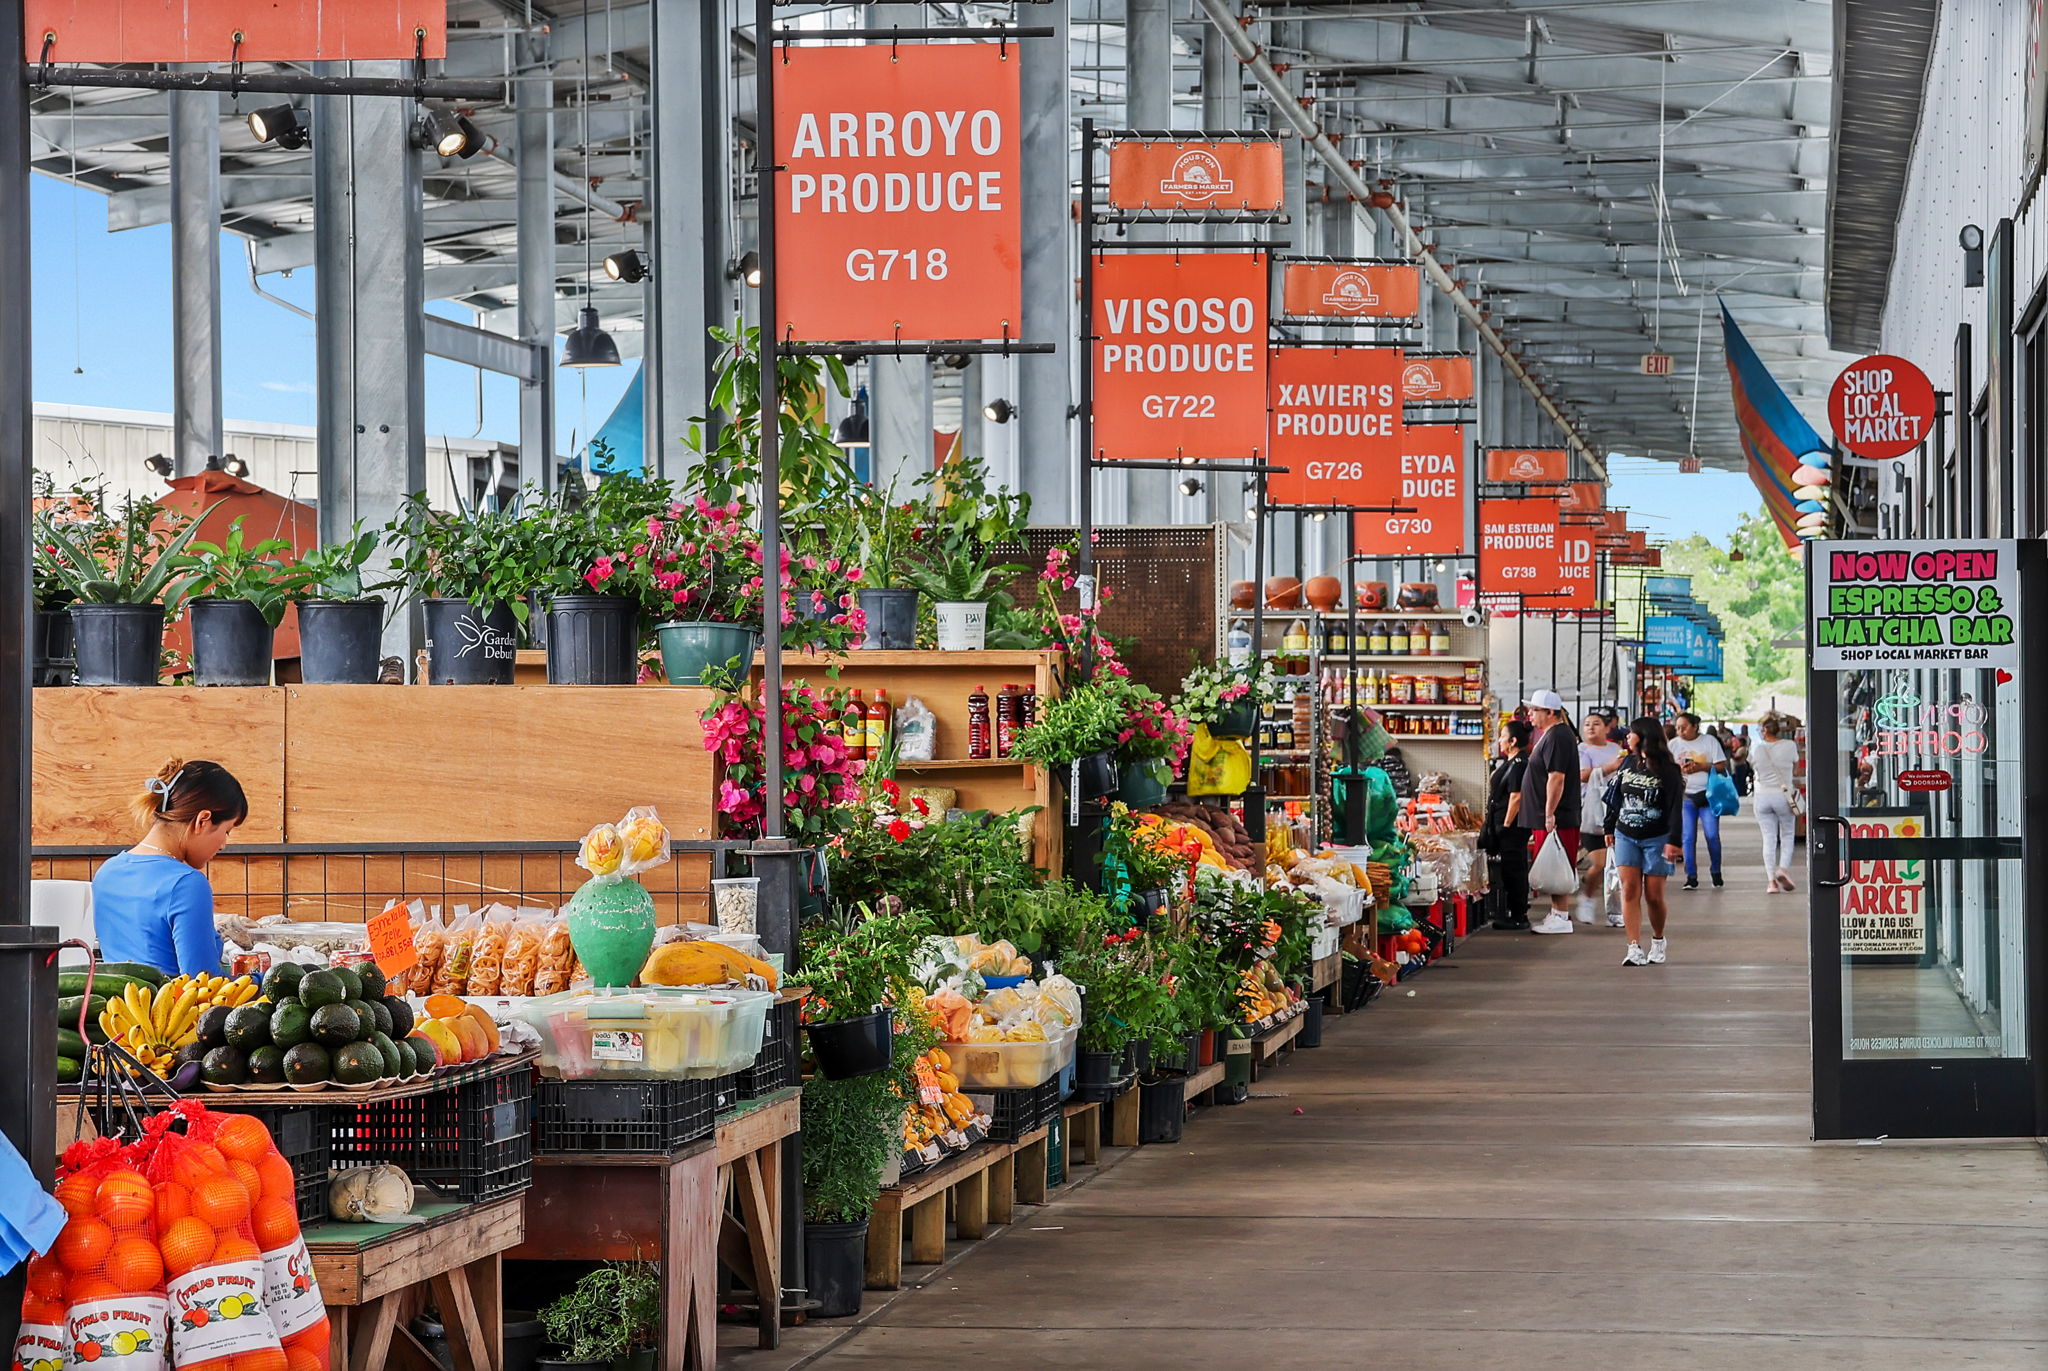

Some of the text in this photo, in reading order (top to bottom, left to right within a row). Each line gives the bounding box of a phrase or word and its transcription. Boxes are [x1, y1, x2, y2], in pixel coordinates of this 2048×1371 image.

[792, 109, 1002, 158] ARROYO
[1179, 155, 1215, 168] HOUSTON
[790, 171, 1002, 213] PRODUCE
[845, 249, 949, 282] G718
[1103, 297, 1255, 334] VISOSO
[1103, 343, 1254, 373] PRODUCE
[1647, 356, 1670, 373] EXIT
[1843, 368, 1893, 395] SHOP
[1141, 395, 1216, 420] G722
[1278, 384, 1393, 407] XAVIER'S
[1843, 393, 1904, 420] LOCAL
[1277, 413, 1392, 437] PRODUCE
[1844, 416, 1922, 443] MARKET
[1306, 461, 1363, 481] G726
[1385, 518, 1432, 534] G730
[1484, 523, 1554, 534] SAN ESTEBAN
[1484, 535, 1554, 549] PRODUCE
[1559, 540, 1590, 563] ID
[1502, 567, 1536, 579] G738
[1830, 550, 1998, 582] NOW OPEN
[1829, 584, 2004, 616] ESPRESSO &
[484, 632, 516, 646] Garden
[1817, 615, 2015, 648] MATCHA BAR
[485, 646, 513, 659] Debut
[1841, 649, 1989, 661] SHOP LOCAL MARKET BAR
[1870, 918, 1876, 928] &
[1879, 917, 1896, 928] TAG
[1899, 917, 1914, 928] US!
[176, 1276, 256, 1310] CITRUS FRUIT
[70, 1310, 151, 1341] CITRUS FRUIT
[38, 1336, 63, 1352] FRU
